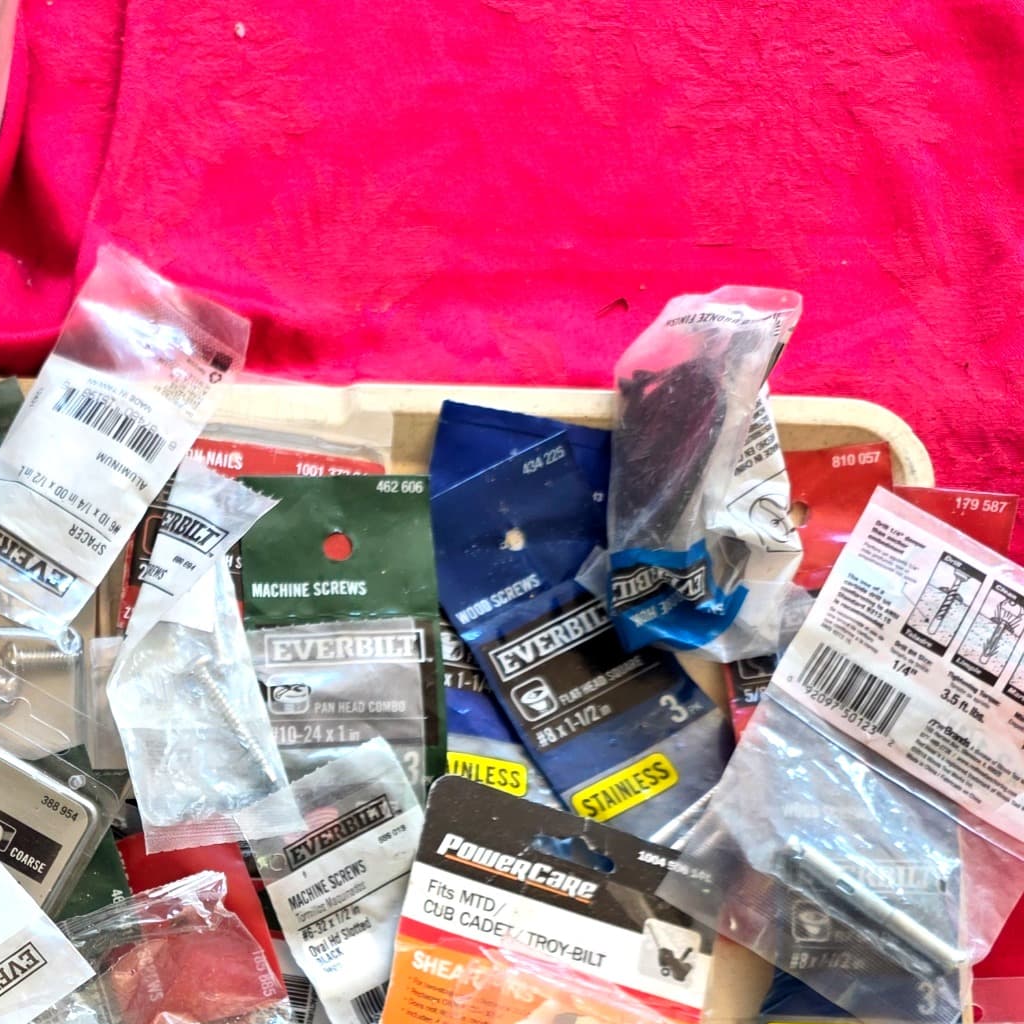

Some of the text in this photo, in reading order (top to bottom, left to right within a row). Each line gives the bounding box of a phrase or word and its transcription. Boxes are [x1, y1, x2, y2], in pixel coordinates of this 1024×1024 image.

[95, 450, 147, 491] ALUMINUM
[205, 452, 324, 477] NAILS 1001
[831, 451, 881, 468] 810 057
[376, 480, 423, 494] 462 606
[956, 496, 1008, 513] 179 587
[68, 526, 107, 555] SPACER
[252, 581, 367, 599] MACHINE SCREWS
[456, 573, 541, 625] WOOD SCREWS
[272, 634, 418, 662] EVERBILT
[890, 658, 918, 680] 1/4"
[313, 701, 406, 713] PAN HEAD COMBO
[939, 687, 960, 706] 3.5
[957, 698, 972, 713] ft.
[968, 705, 988, 723] lbs.
[403, 751, 419, 784] 3
[582, 761, 670, 818] STAINLESS
[41, 795, 80, 822] 388 954
[290, 801, 388, 865] EVERBILT
[9, 847, 47, 874] COARSE
[286, 858, 368, 910] MACHINE SCREWS
[428, 879, 506, 917] Fits MTD/
[299, 919, 329, 941] #6-32
[327, 918, 334, 928] x
[334, 908, 351, 924] 1/2
[307, 916, 372, 957] Oval Hd Slotted
[424, 899, 453, 921] CUB
[527, 930, 606, 968] TROY-BILT
[917, 981, 937, 1016] 3
